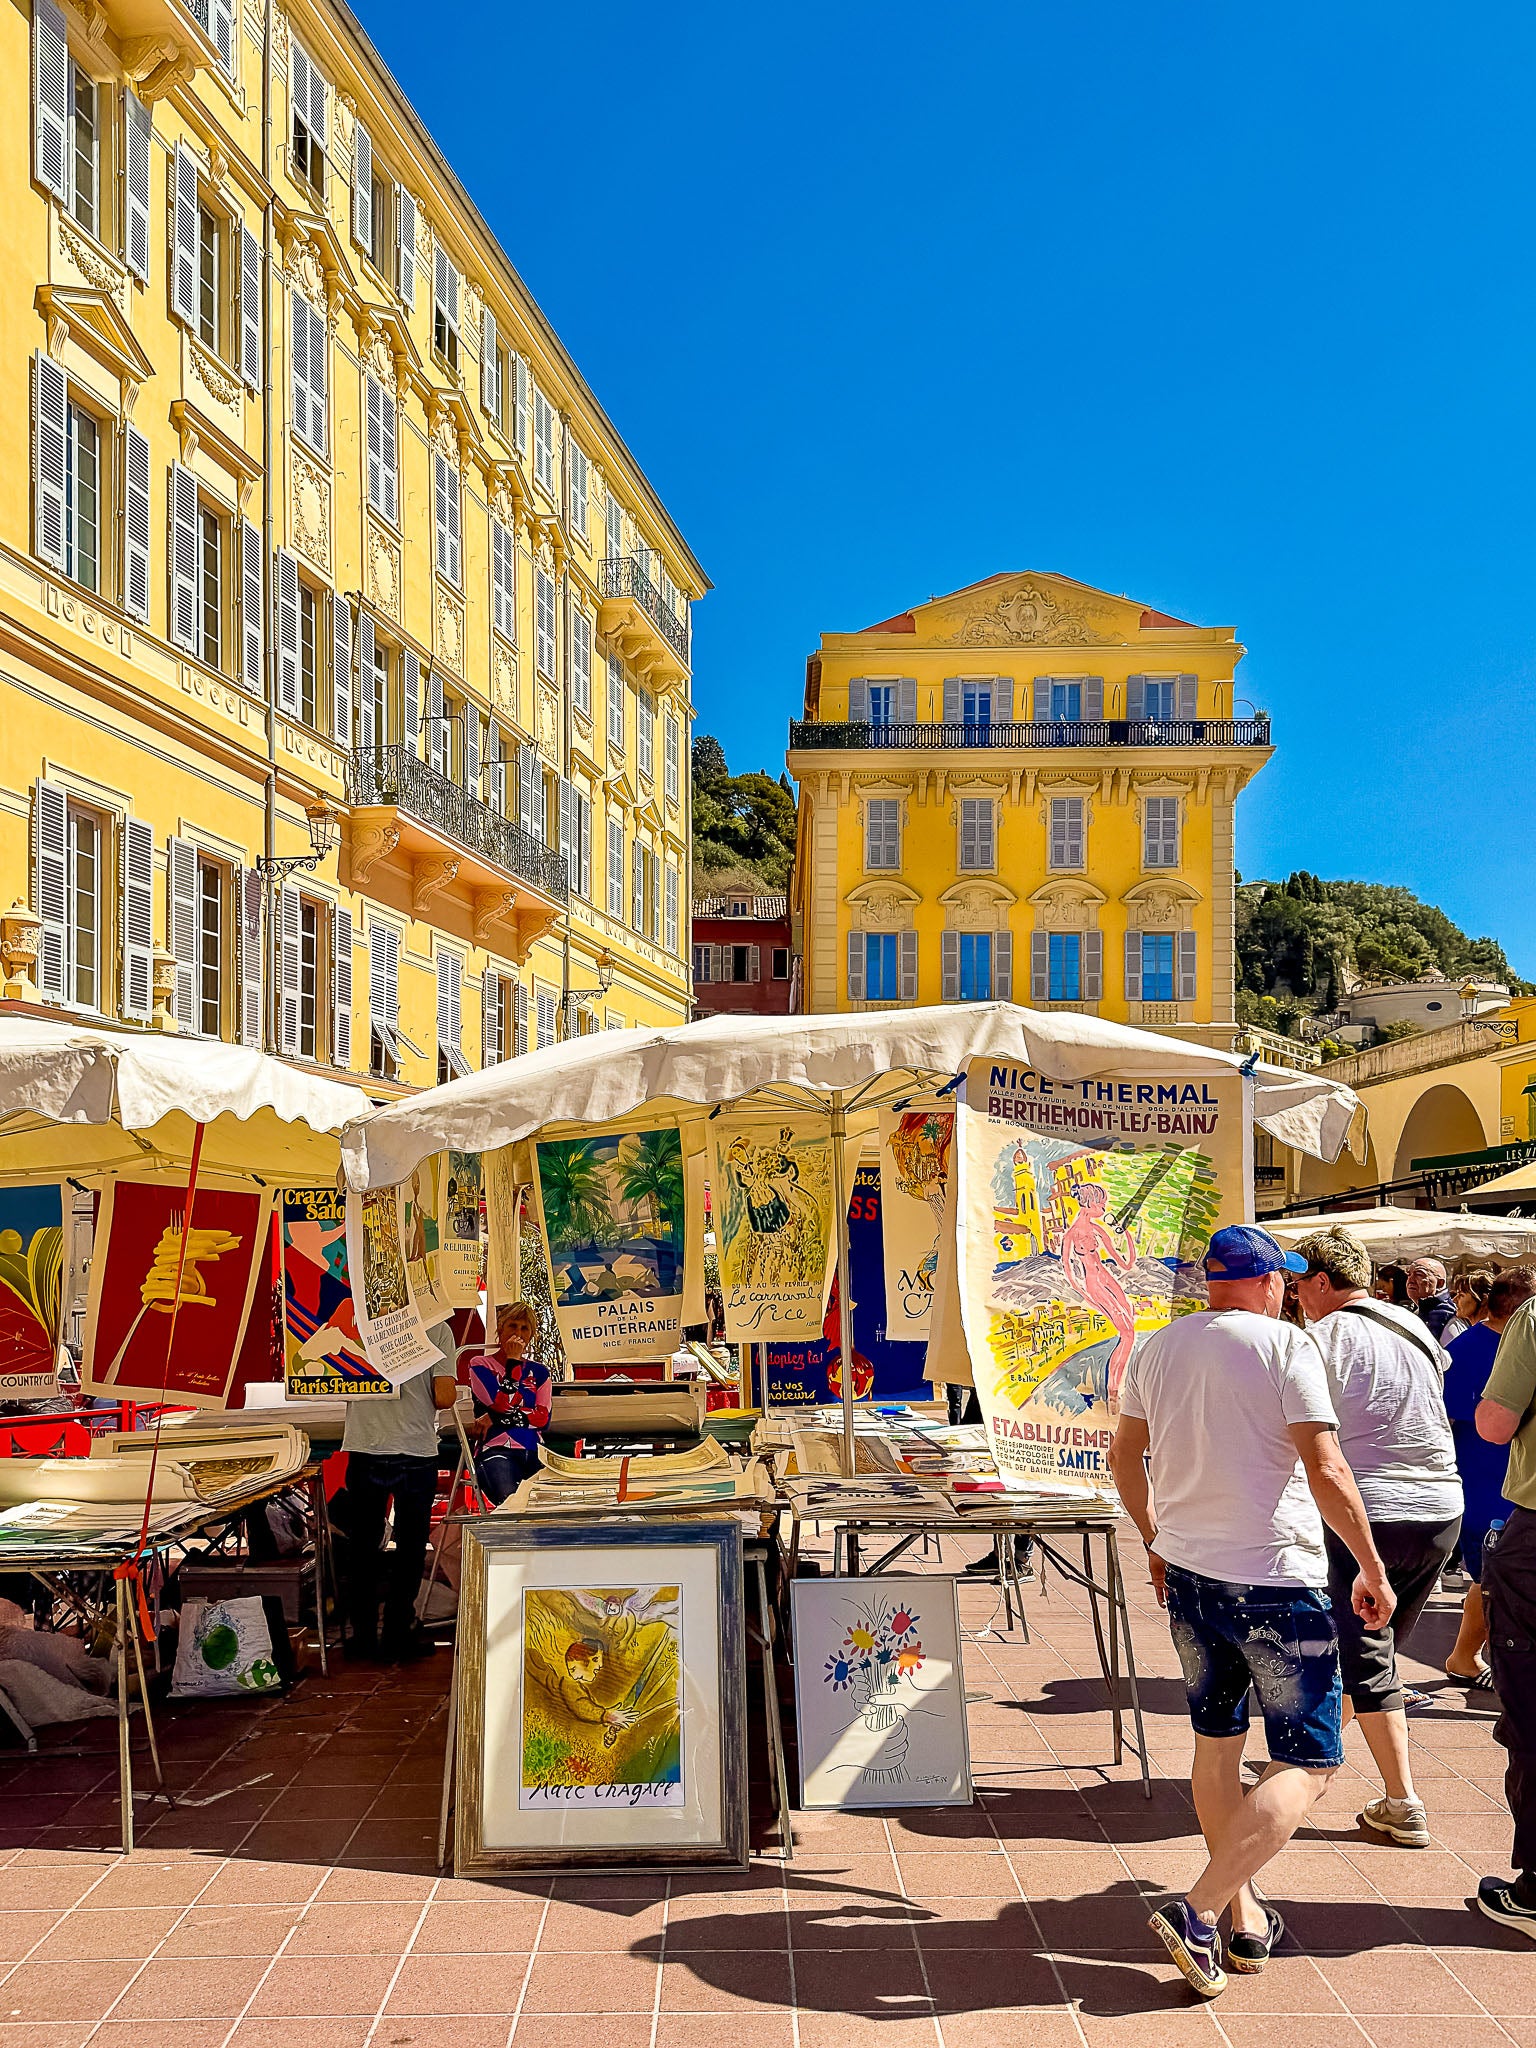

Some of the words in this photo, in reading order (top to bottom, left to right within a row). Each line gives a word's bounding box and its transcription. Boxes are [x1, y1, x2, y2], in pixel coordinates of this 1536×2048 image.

[989, 1066, 1054, 1094] NICE
[1079, 1081, 1218, 1104] THERMAL
[988, 1097, 1219, 1134] BERTHEMONT-LES-BAINS
[1506, 1149, 1522, 1161] LES
[284, 1189, 339, 1205] Crazy
[728, 1288, 747, 1308] Le
[749, 1286, 816, 1302] carnaval
[598, 1301, 655, 1317] PALAIS
[736, 1303, 807, 1330] Nice
[603, 1340, 621, 1348] NICE
[1, 1375, 43, 1387] COUNTRY
[785, 1382, 803, 1391] vos
[1030, 1466, 1052, 1474] BAINS
[529, 1780, 586, 1800] Marc
